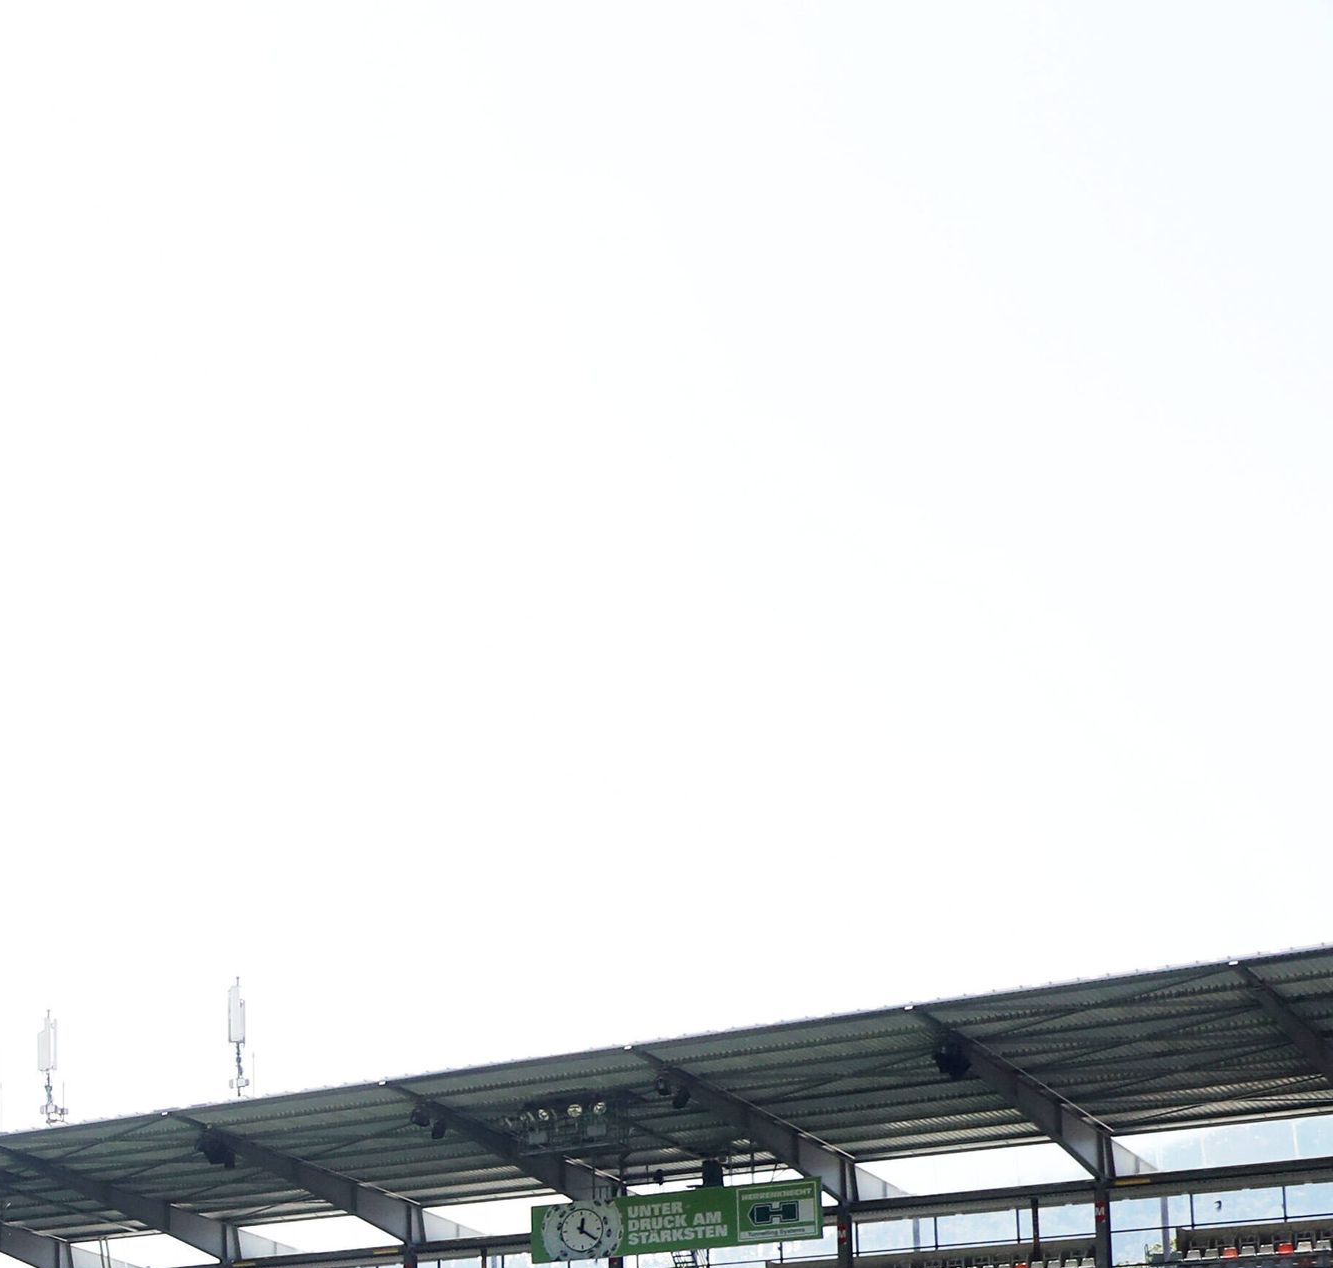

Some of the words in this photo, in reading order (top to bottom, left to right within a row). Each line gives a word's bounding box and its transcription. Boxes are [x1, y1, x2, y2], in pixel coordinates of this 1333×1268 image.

[628, 1202, 682, 1218] UNTER
[628, 1214, 685, 1231] DRUCK
[693, 1211, 722, 1226] AM
[628, 1224, 728, 1246] STÄRKSTEN
